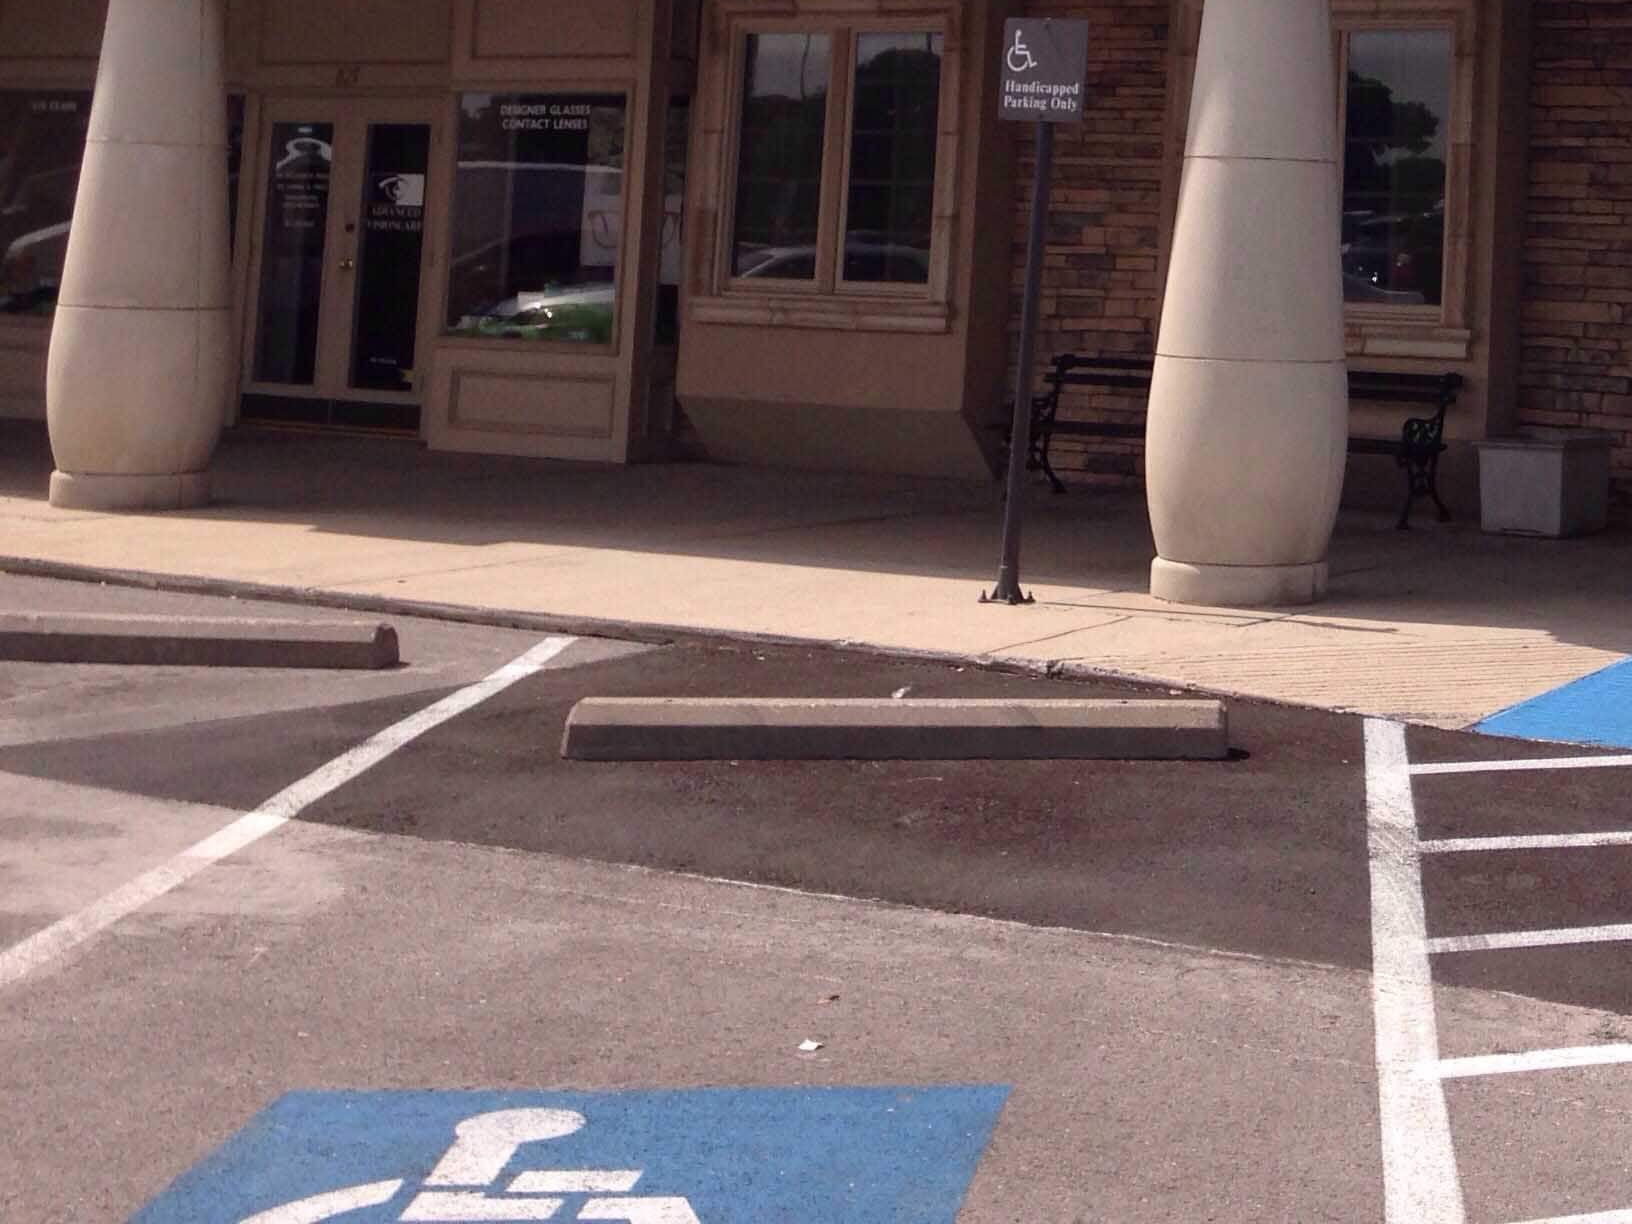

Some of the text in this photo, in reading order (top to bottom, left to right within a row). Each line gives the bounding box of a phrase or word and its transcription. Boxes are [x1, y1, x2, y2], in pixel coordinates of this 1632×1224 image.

[1005, 79, 1079, 96] Handicapped
[500, 104, 591, 116] DESIGNER GLASSES
[1004, 95, 1077, 112] Parking Only
[502, 118, 588, 130] CONTACT LENSES
